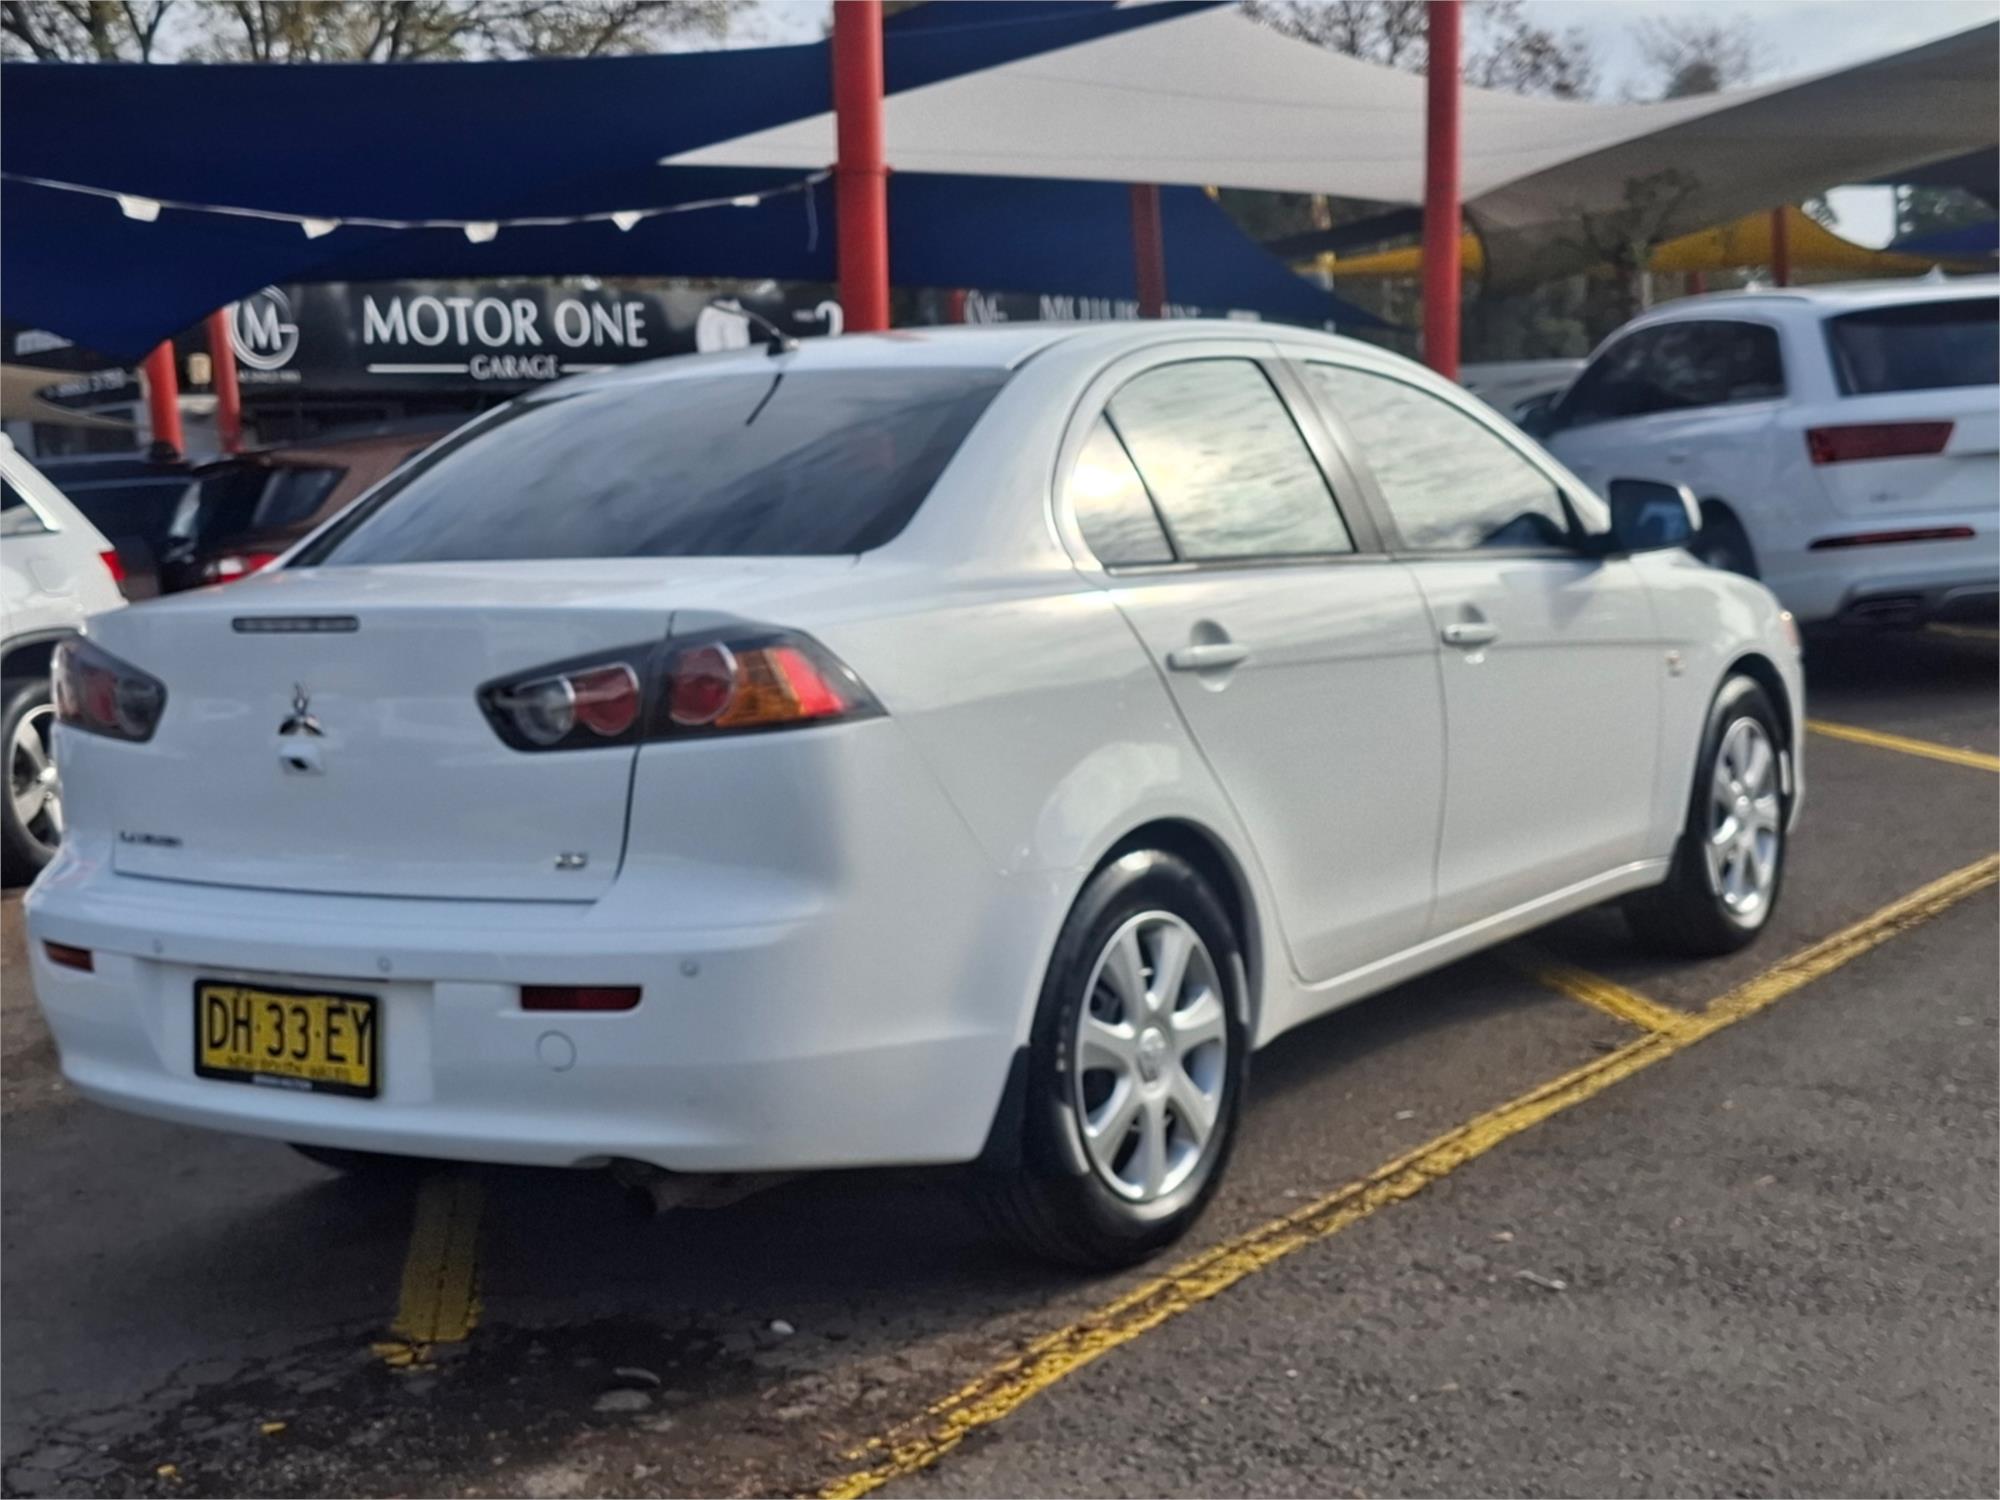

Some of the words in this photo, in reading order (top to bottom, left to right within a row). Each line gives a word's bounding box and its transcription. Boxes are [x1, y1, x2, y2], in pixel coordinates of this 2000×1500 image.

[363, 294, 543, 348] MOTOR
[554, 298, 648, 348] ONE
[469, 354, 559, 381] GARAGE
